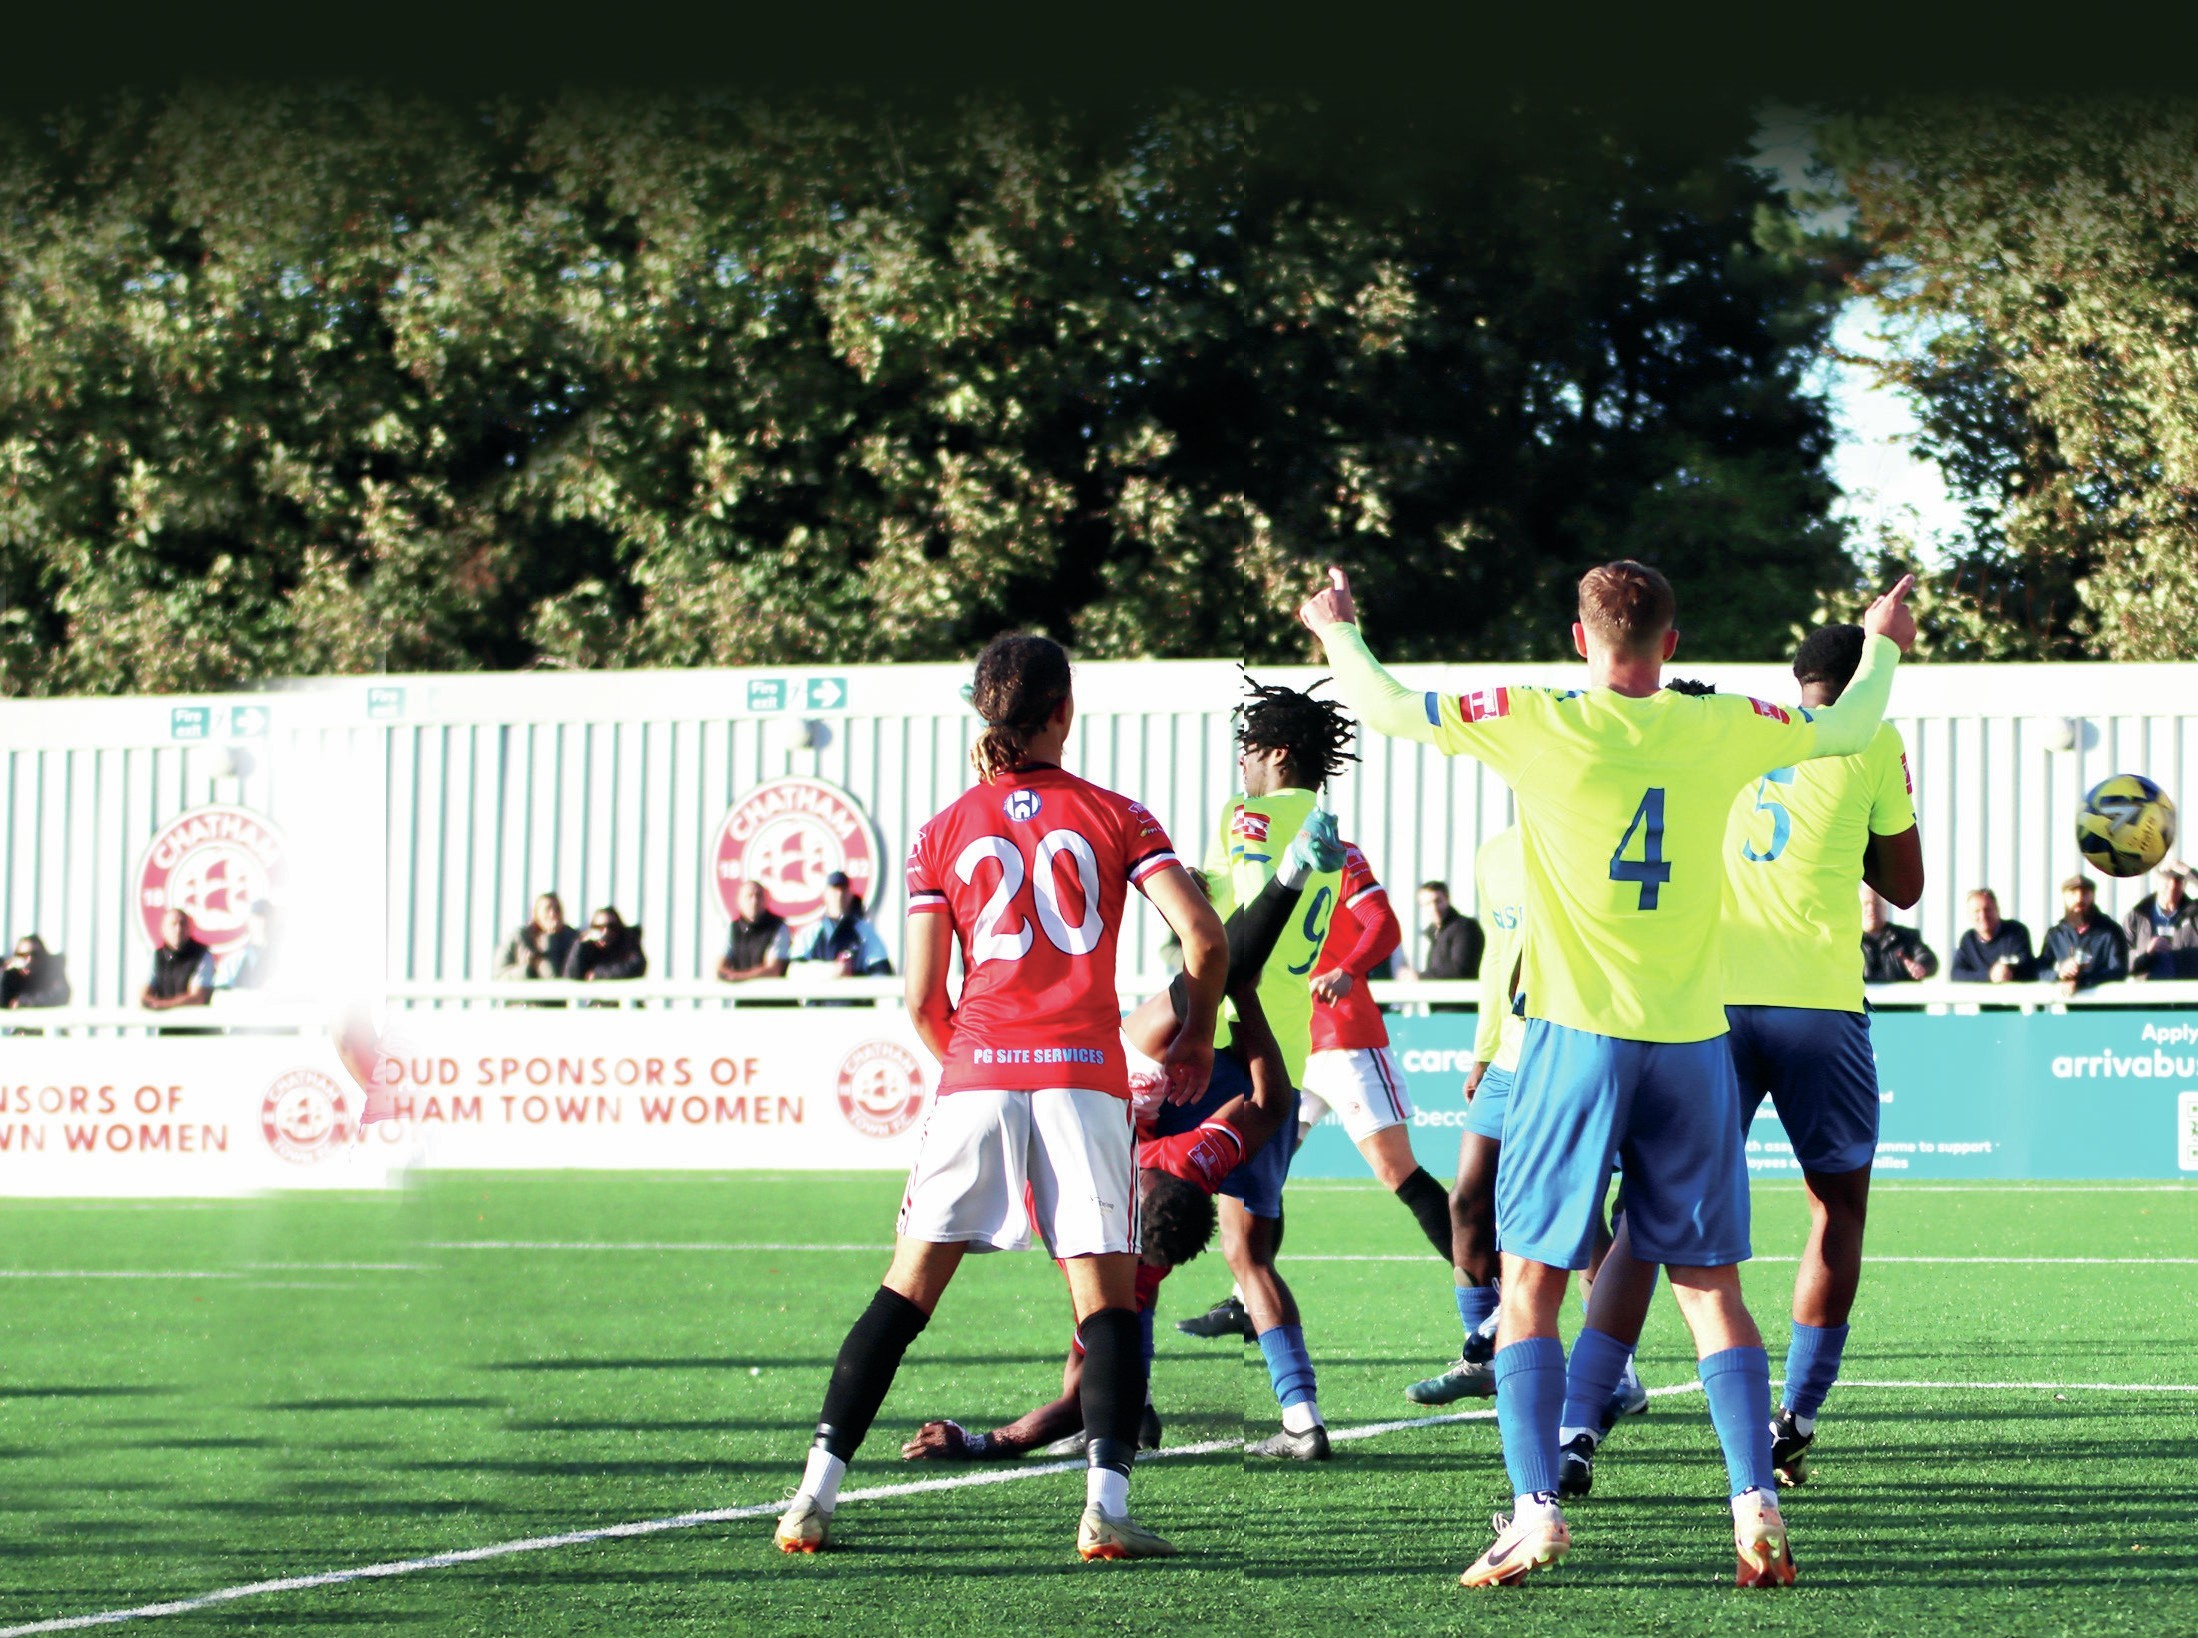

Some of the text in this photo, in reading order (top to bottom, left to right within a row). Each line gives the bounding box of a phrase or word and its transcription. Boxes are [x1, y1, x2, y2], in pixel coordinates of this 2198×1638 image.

[751, 681, 779, 696] Fire
[175, 708, 203, 724] Fire
[751, 696, 779, 711] exit
[175, 723, 203, 738] exit
[728, 785, 858, 842] CHATHAM
[1742, 767, 1796, 862] 5
[1609, 787, 1672, 911] 4
[954, 828, 1104, 966] 20
[1287, 886, 1332, 975] 9
[973, 1048, 1105, 1065] PG SITE SERVICES
[2051, 1047, 2198, 1079] arrivabu
[477, 1057, 692, 1086] SPONSORS
[709, 1057, 760, 1086] OF
[134, 1085, 183, 1114] OF
[500, 1095, 622, 1124] TOWN
[639, 1095, 804, 1124] WOMEN
[63, 1123, 229, 1152] WOMEN
[1920, 1139, 1935, 1153] to
[1937, 1140, 1993, 1156] support
